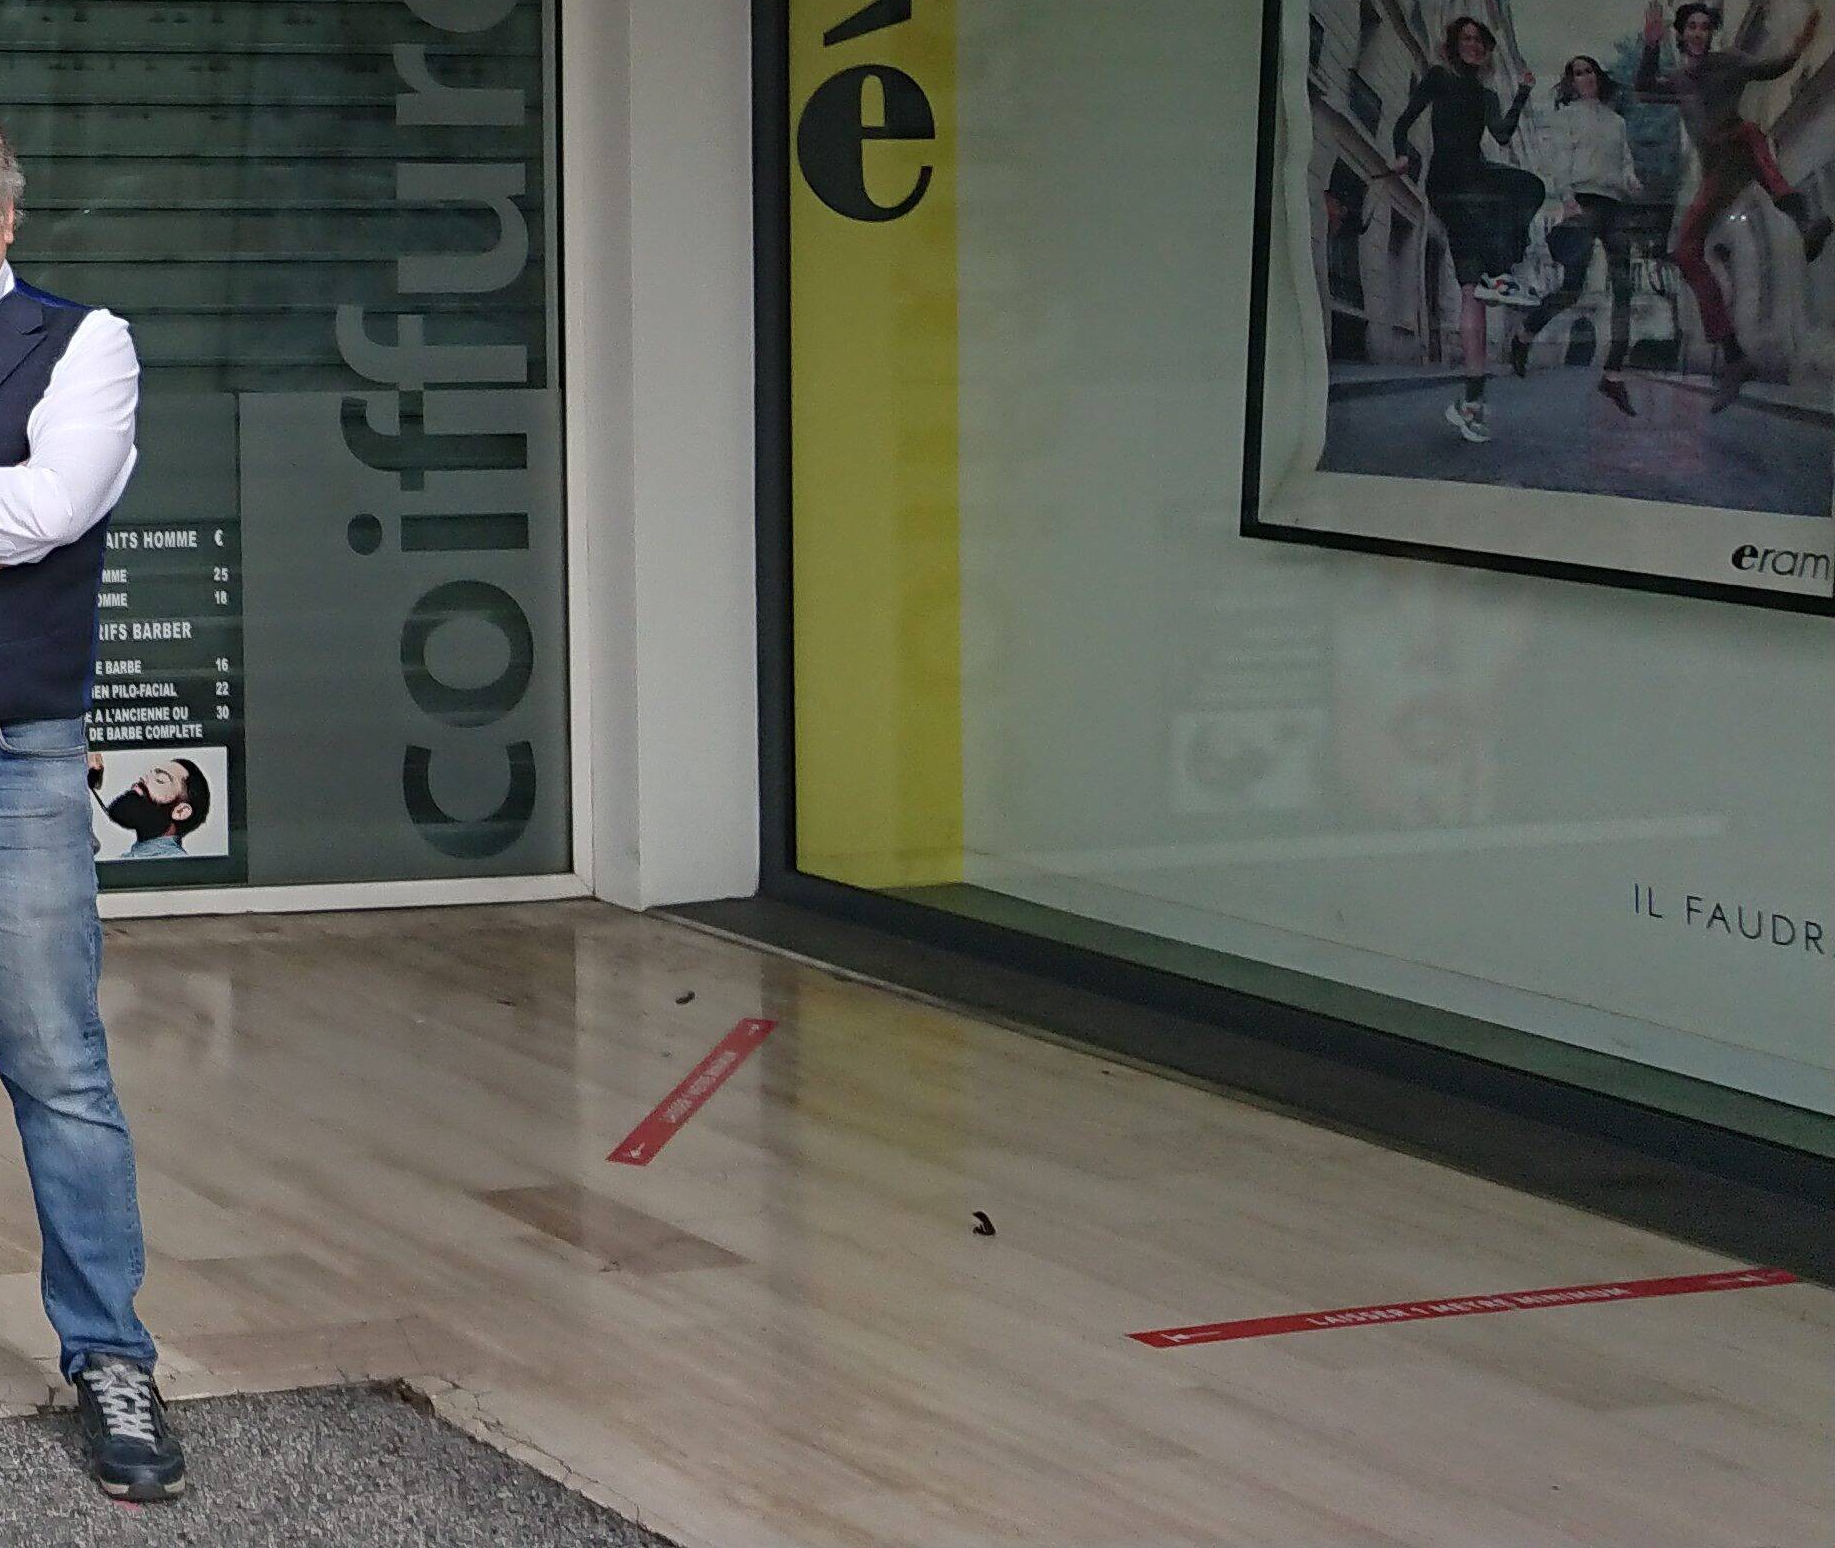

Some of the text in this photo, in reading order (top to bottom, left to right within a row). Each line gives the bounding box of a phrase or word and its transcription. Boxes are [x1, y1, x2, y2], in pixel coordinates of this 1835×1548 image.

[106, 531, 138, 548] AITS
[143, 531, 197, 549] HOMME
[1731, 542, 1831, 581] eram
[102, 568, 228, 583] MME 25
[214, 591, 227, 605] 18
[133, 622, 192, 640] BARBER
[106, 658, 228, 674] BARBE 16
[112, 682, 229, 698] PILO-FACIAL 22
[95, 706, 229, 722] A L'ANCIENNE OU 30
[89, 724, 203, 741] DE BARBE COMPLETE
[1633, 882, 1835, 956] IL FAUDR
[1306, 1308, 1410, 1325] LAISSER
